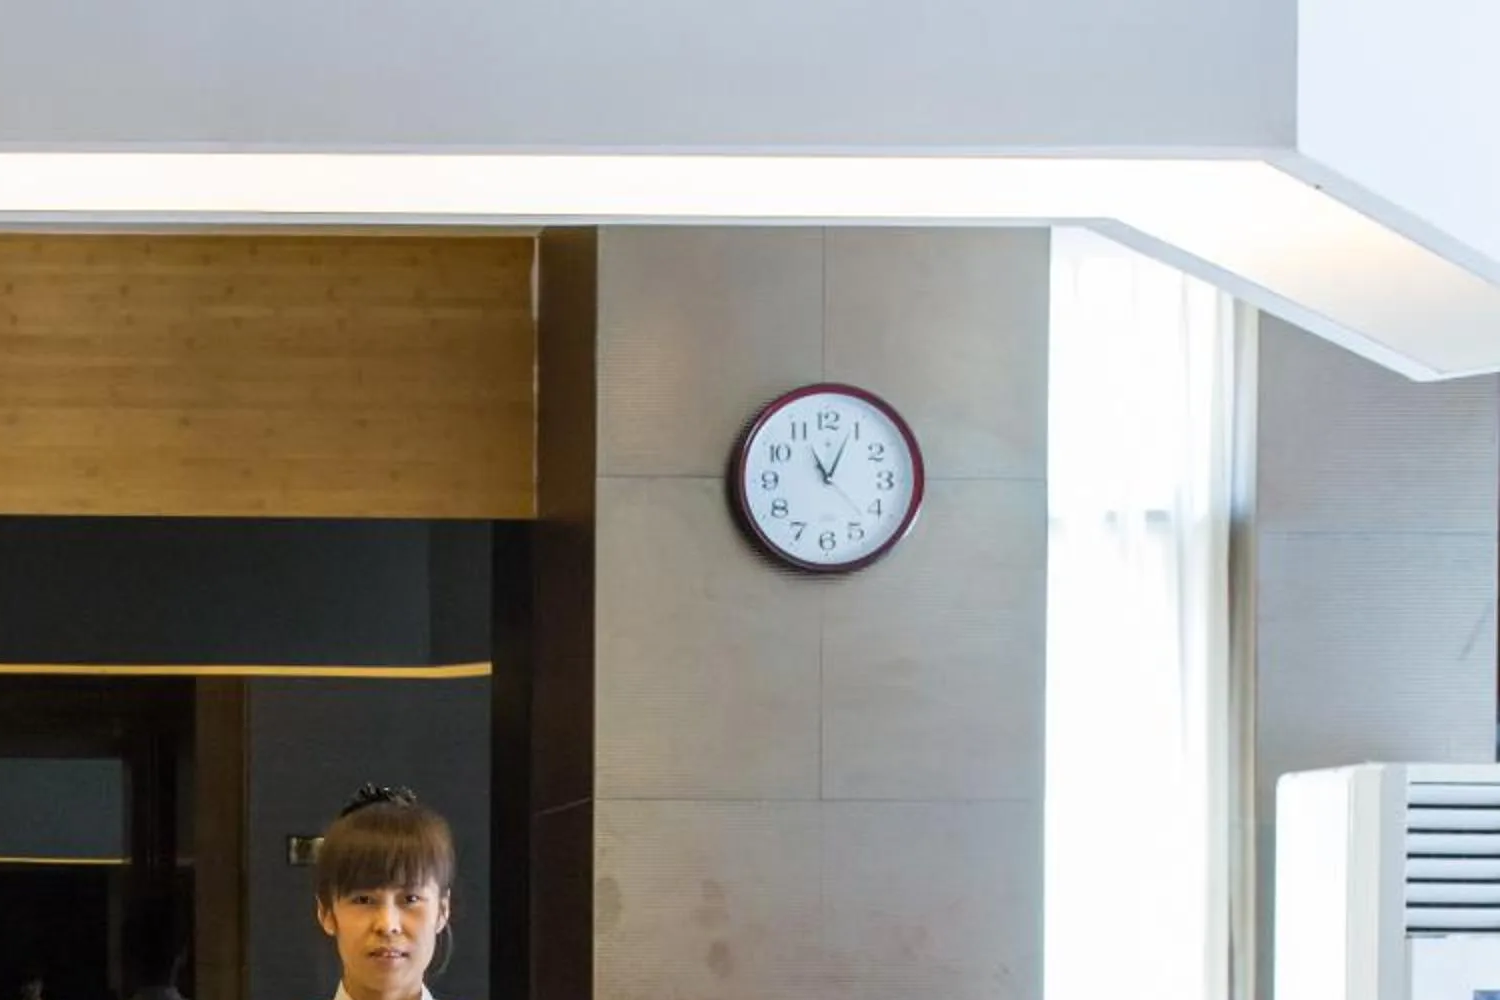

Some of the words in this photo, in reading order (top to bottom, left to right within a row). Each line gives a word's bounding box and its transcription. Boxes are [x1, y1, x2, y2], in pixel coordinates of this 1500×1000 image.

[791, 421, 807, 441] 11
[816, 411, 840, 431] 12
[853, 421, 860, 441] 1
[769, 444, 791, 464] 10
[868, 442, 884, 462] 2
[761, 470, 779, 490] 9
[876, 470, 894, 491] 3
[771, 499, 789, 519] 8
[867, 498, 882, 519] 4
[789, 521, 805, 542] 7
[818, 530, 836, 551] 6
[847, 522, 864, 541] 5
